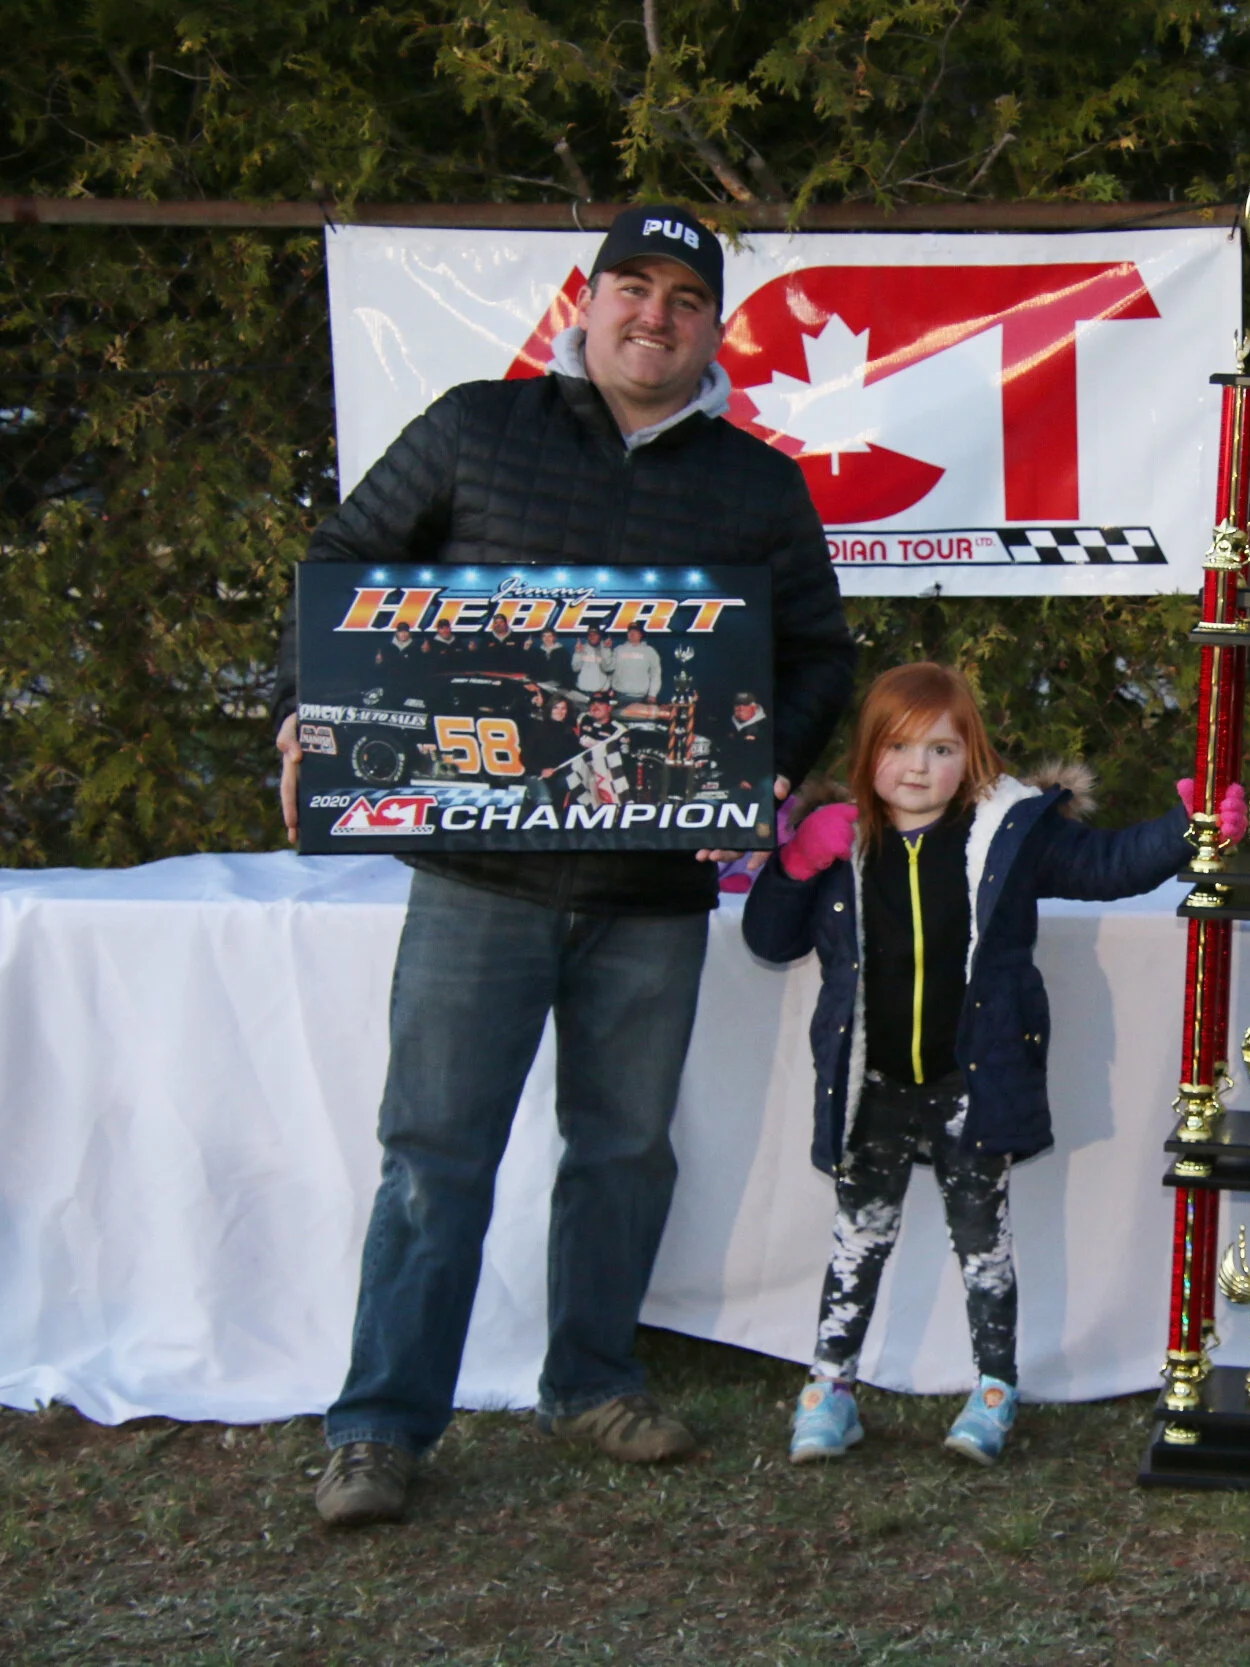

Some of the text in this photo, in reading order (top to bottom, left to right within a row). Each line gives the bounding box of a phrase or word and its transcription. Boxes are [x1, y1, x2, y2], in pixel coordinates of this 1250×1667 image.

[642, 219, 700, 249] PUB
[898, 538, 973, 561] TOUR
[975, 537, 996, 548] LTD.
[492, 577, 597, 605] Jimmy
[334, 587, 746, 633] HEBERT
[389, 713, 427, 727] SALES
[433, 716, 526, 777] 58
[309, 795, 760, 829] 2020 ACT CHAMPION
